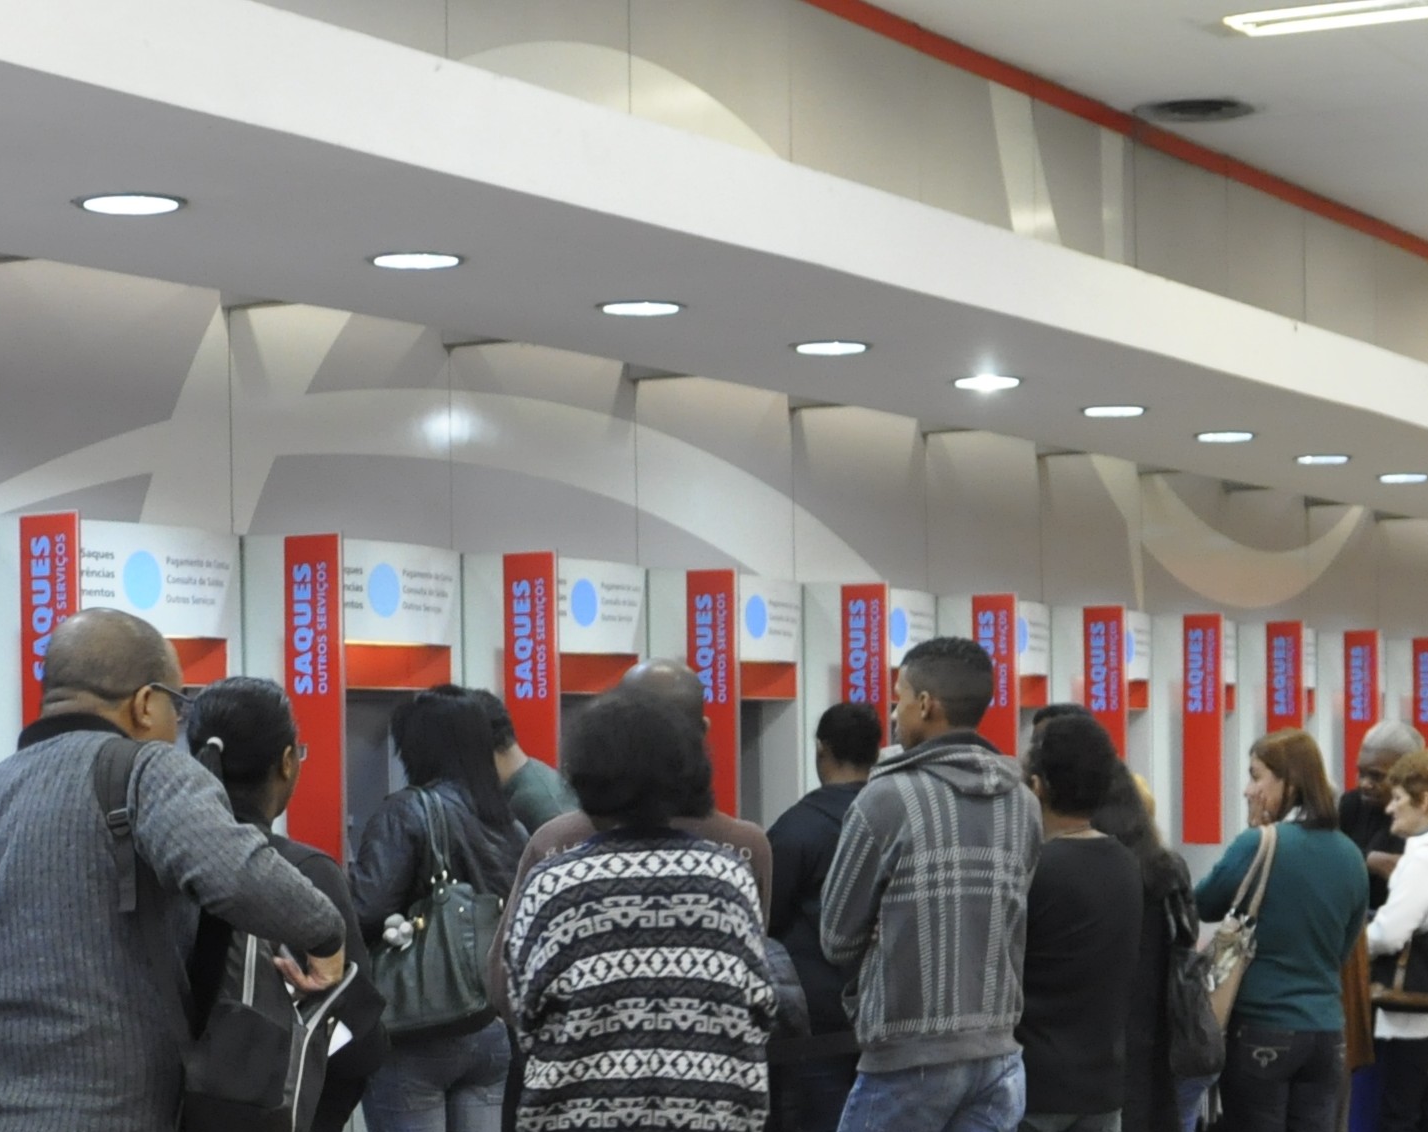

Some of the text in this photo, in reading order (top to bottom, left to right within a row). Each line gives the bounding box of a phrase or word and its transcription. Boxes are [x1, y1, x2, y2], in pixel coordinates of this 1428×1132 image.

[55, 532, 69, 610] SERVIÇOS
[293, 563, 314, 695] SAQUES
[316, 561, 329, 695] OUTROS SERVIÇOS
[512, 579, 534, 700] SAQUES
[534, 577, 548, 698] OUTROS SERVIÇOS
[695, 593, 715, 704] SAQUES
[716, 592, 727, 703] OUTROS SERVIÇOS
[849, 599, 868, 704] SAQUES
[869, 598, 880, 702] OUTROS SERVIÇOS
[1090, 621, 1107, 712] SAQUES
[1188, 628, 1204, 714] SAQUES
[1273, 635, 1287, 716] SAQUES
[998, 663, 1008, 707] OUTROS
[1350, 646, 1364, 721] SAQUES
